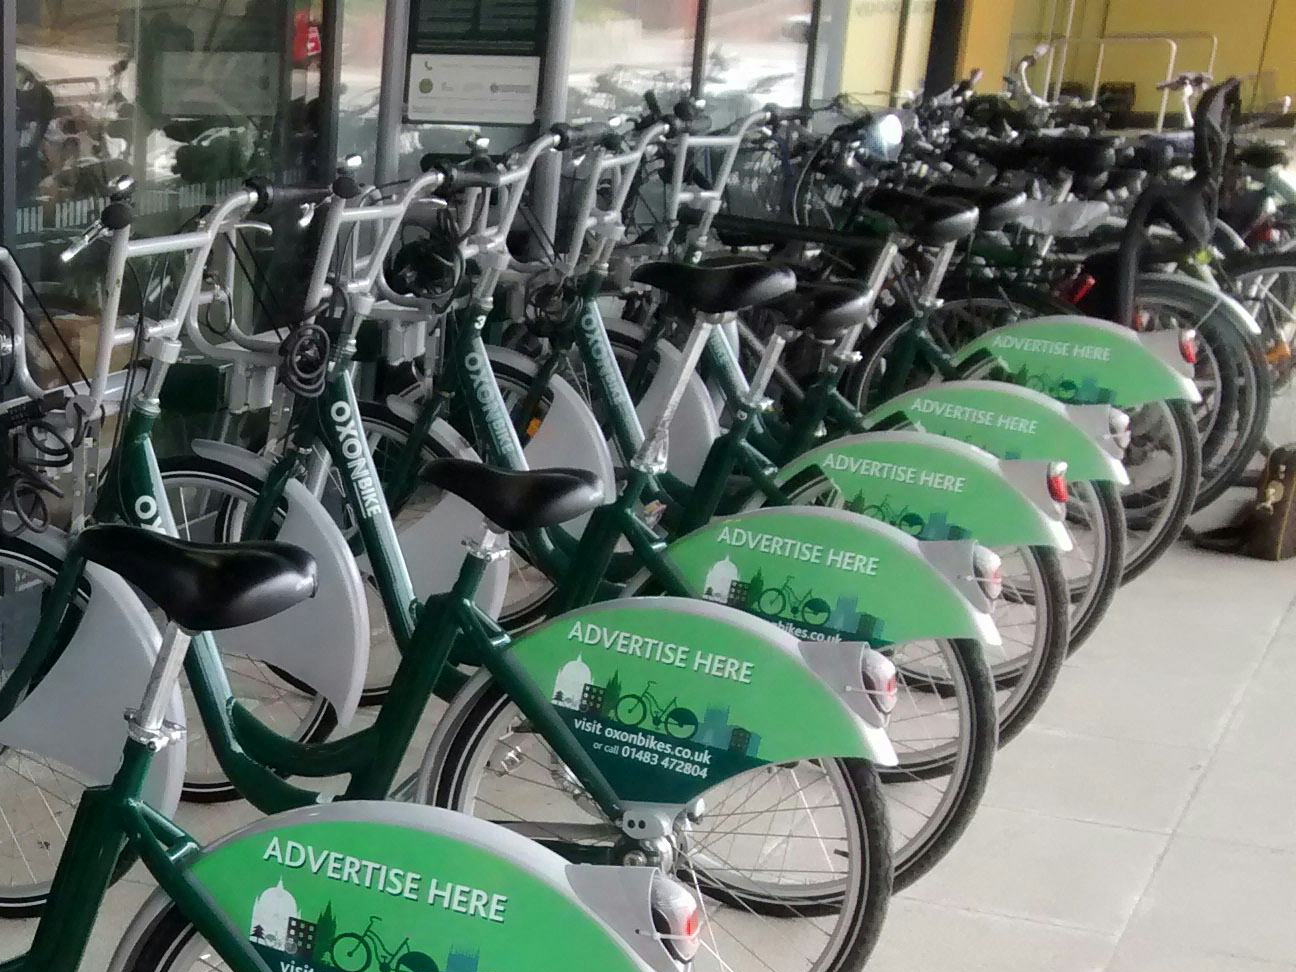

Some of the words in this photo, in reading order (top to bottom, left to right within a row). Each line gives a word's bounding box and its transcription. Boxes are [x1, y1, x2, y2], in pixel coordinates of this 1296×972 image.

[992, 335, 1071, 359] ADVERTISE
[1073, 344, 1111, 361] HERE
[911, 398, 992, 427] ADVERTISE
[996, 412, 1039, 435] HERE
[330, 400, 382, 517] OXONBIKE
[823, 453, 916, 484] ADVERTISE
[920, 470, 966, 493] HERE
[716, 526, 824, 564] ADVERTISE
[827, 552, 881, 577] HERE
[568, 620, 687, 669] ADVERTISE
[693, 650, 755, 685] HERE
[774, 620, 843, 644] bikes.co.uk
[574, 717, 603, 735] visit
[604, 727, 713, 765] oxonbikes.co.uk
[592, 741, 603, 750] or
[604, 744, 620, 756] call
[621, 745, 659, 766] 01483
[661, 757, 708, 779] 472804
[262, 835, 423, 901] ADVERTISE
[427, 876, 509, 925] HERE
